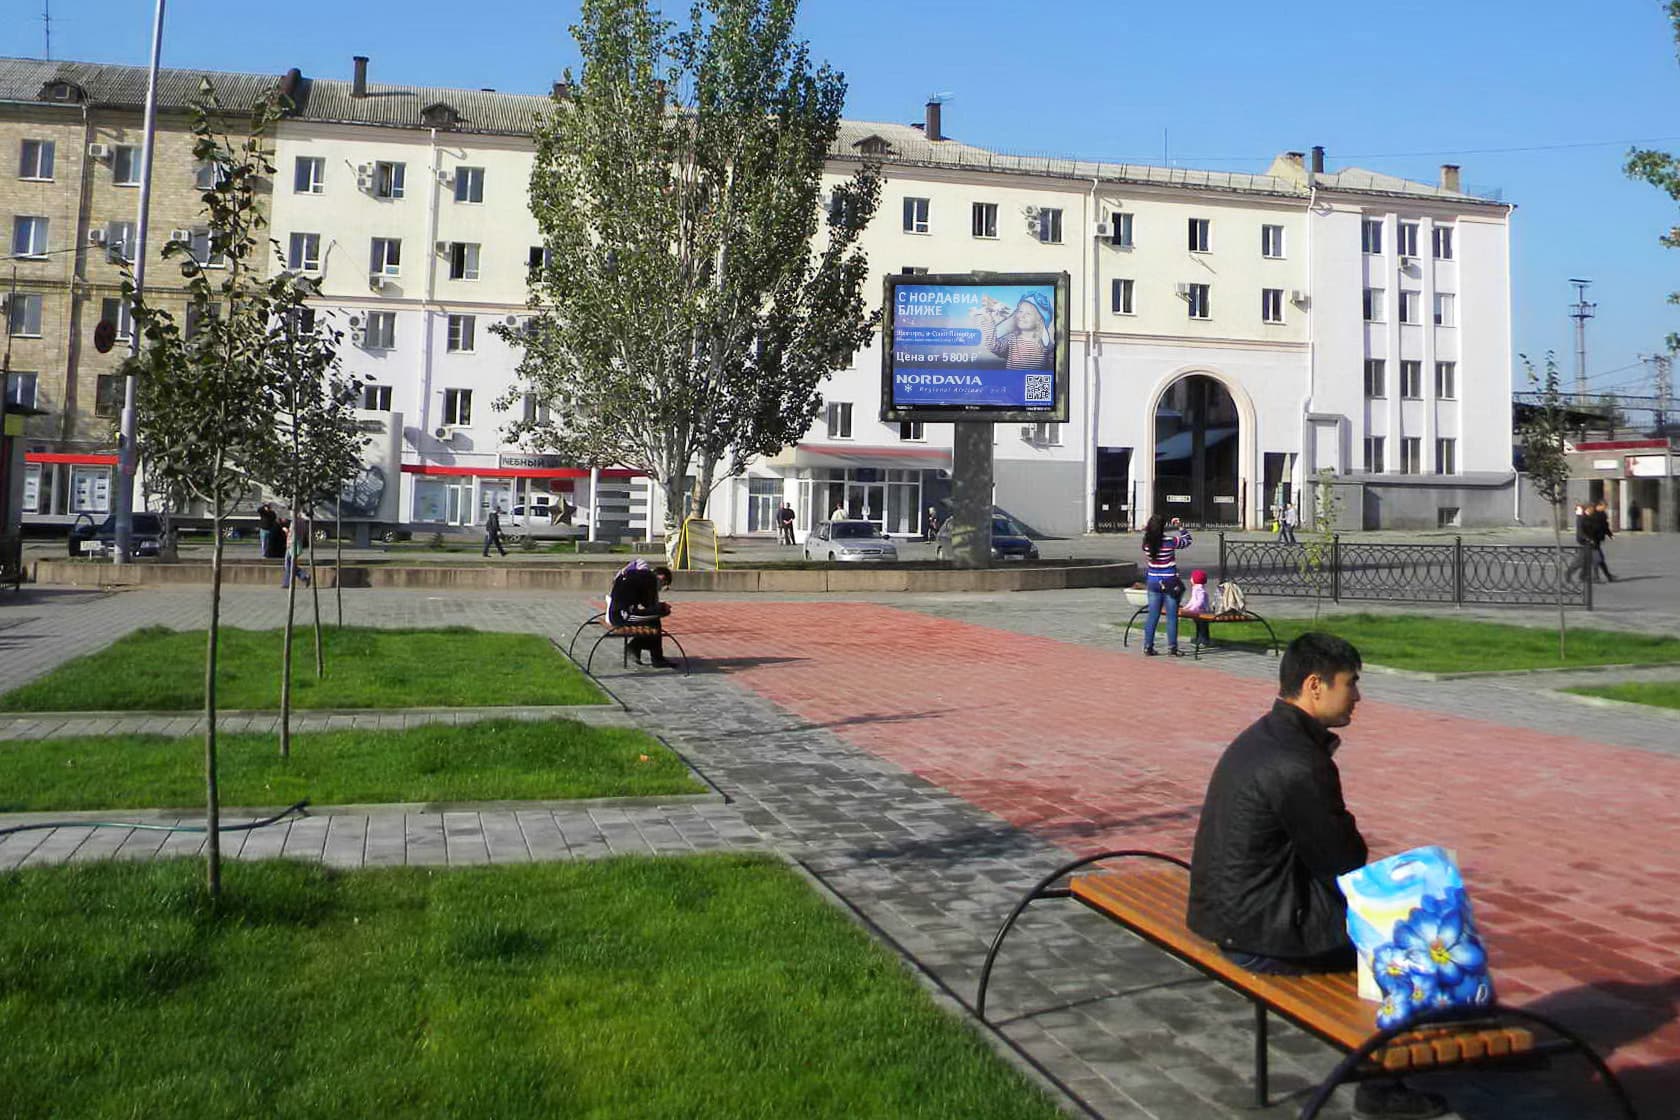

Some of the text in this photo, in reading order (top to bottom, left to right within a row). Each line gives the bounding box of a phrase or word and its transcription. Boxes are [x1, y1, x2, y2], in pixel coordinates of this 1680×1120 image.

[898, 291, 979, 304] С НОРДАВИА
[898, 304, 943, 316] БЛИЖЕ
[896, 351, 925, 363] Цена
[927, 354, 940, 362] от
[896, 374, 983, 386] NORDAVIA
